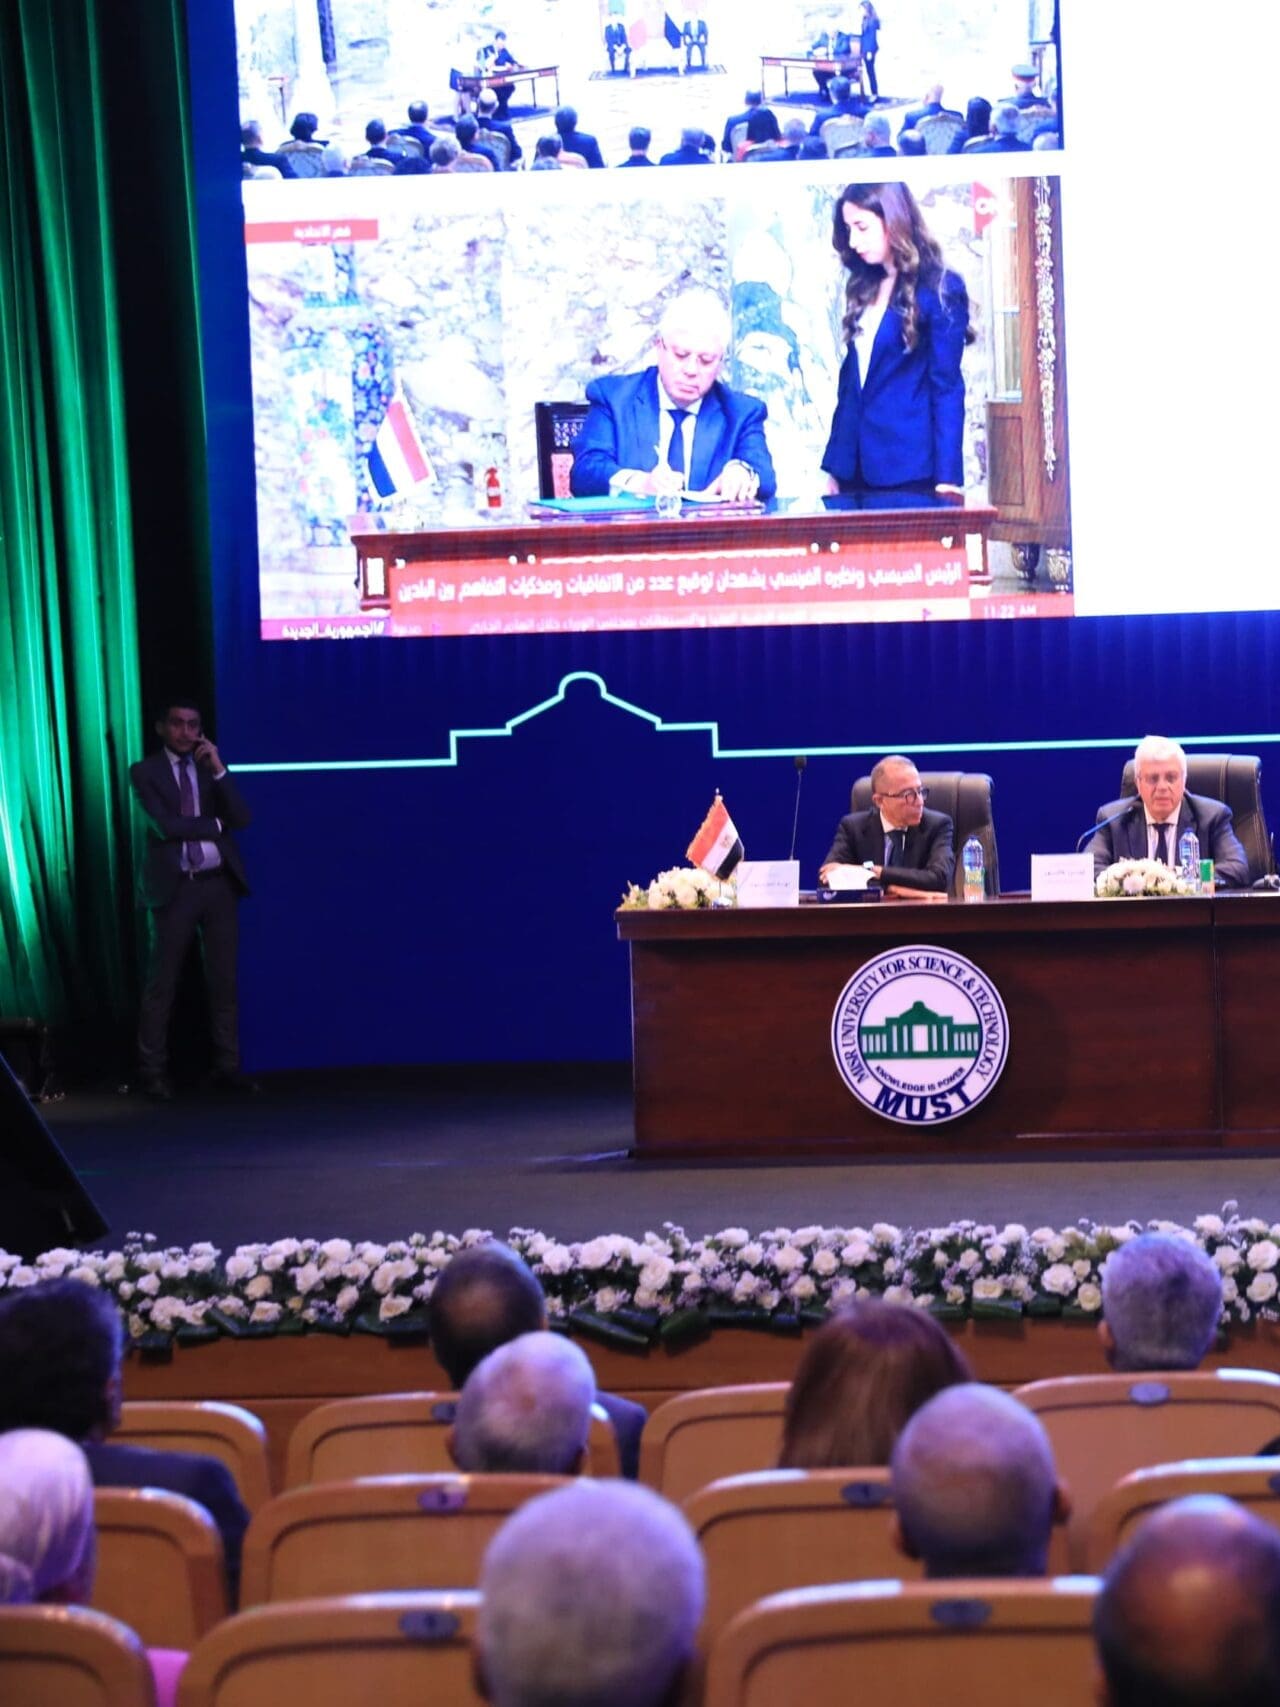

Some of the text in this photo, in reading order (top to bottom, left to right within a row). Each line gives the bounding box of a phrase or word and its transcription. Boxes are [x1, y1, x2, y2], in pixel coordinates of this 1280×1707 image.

[566, 573, 623, 596] الاتفاقيات
[627, 577, 644, 595] من
[649, 575, 674, 592] عدد
[677, 571, 713, 595] توقيع
[716, 568, 767, 592] يشهدان
[769, 566, 821, 590] الفرنسي
[825, 565, 864, 589] ونظيره
[868, 564, 921, 588] السيسي
[925, 562, 961, 587] الرئيس
[399, 578, 435, 603] البلدين
[458, 577, 506, 602] التفاهم
[1020, 604, 1036, 616] AM
[842, 956, 999, 1084] MISR UNIVERSITY FOR SCIENCE & TECHNOLOGY
[875, 1065, 966, 1092] KNOWLEDGE IS POWER
[874, 1079, 974, 1121] MUST
